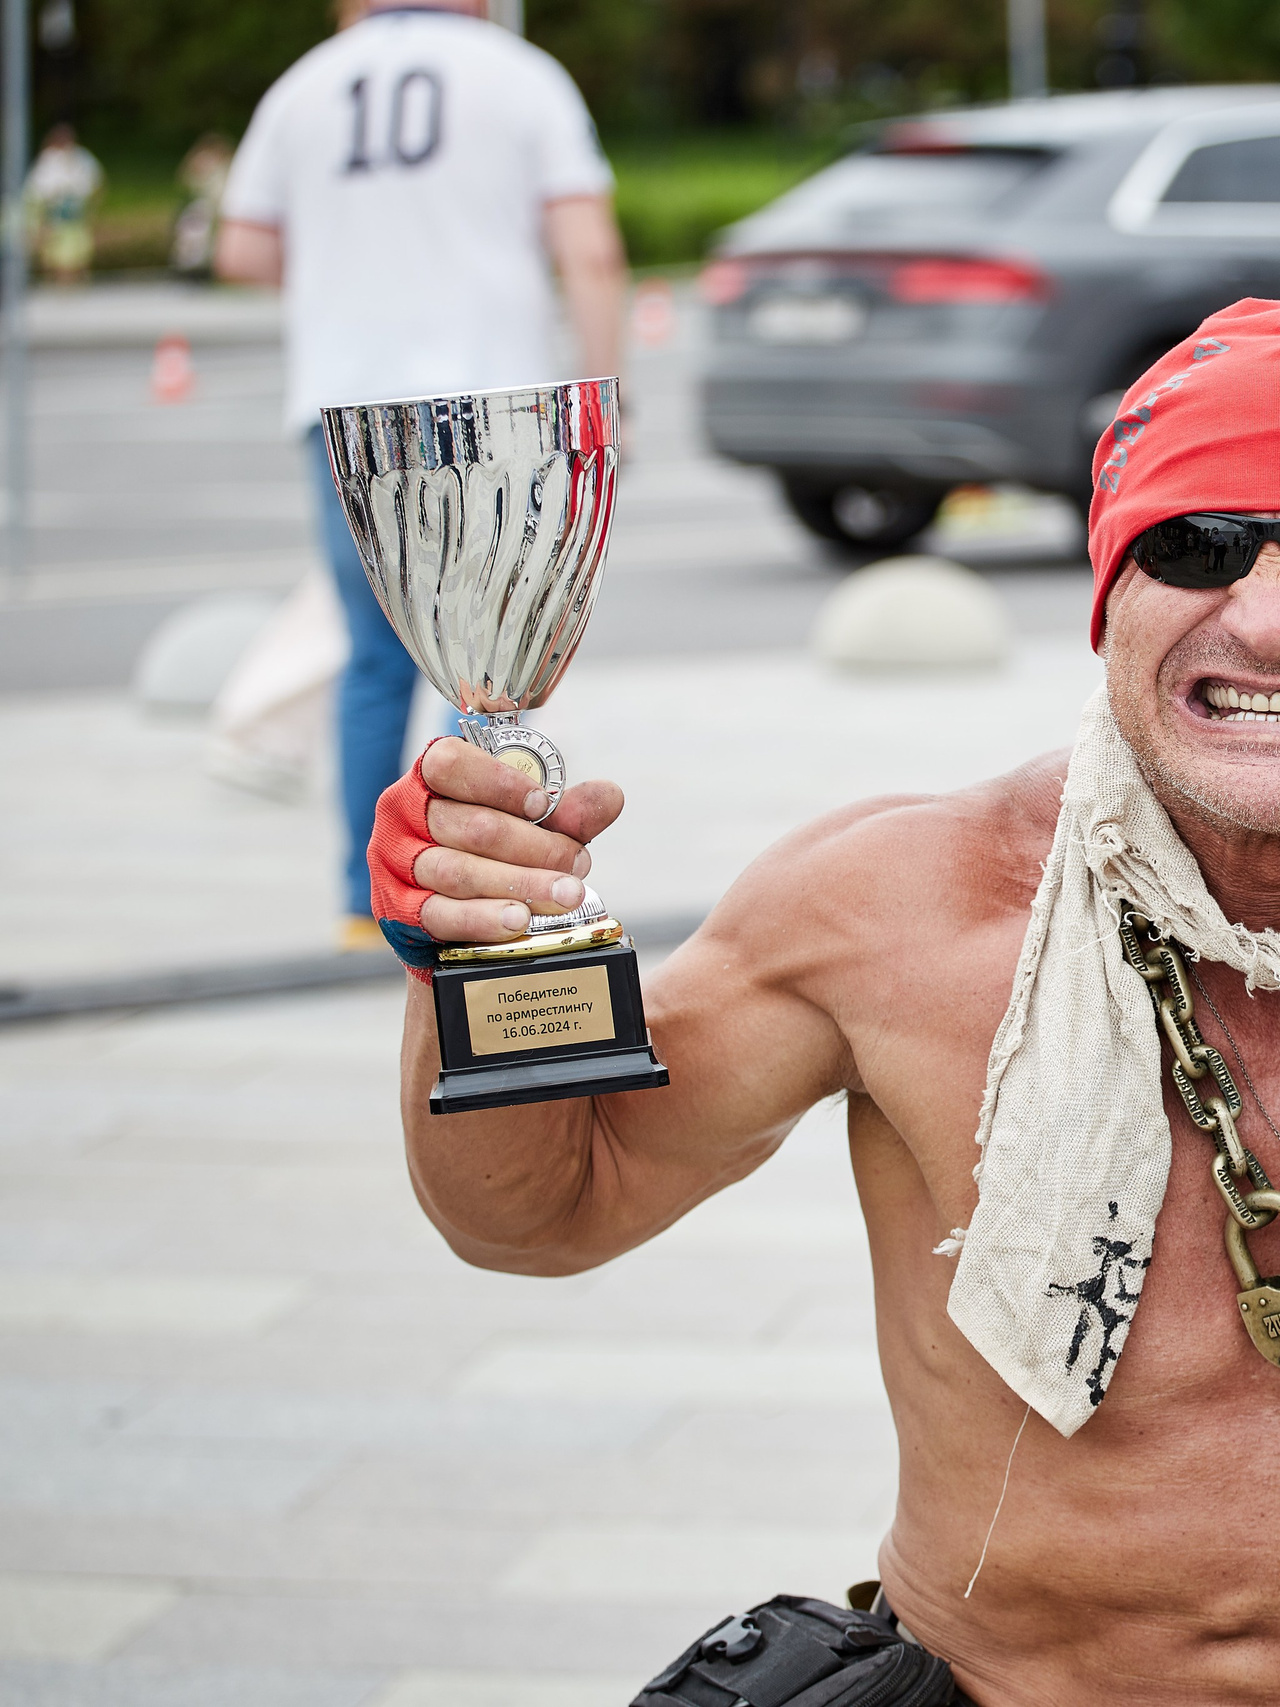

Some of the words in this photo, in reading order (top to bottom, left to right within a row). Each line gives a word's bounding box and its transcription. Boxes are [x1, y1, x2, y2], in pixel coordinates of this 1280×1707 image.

[342, 68, 443, 175] 10
[1100, 337, 1231, 494] ZUBV
[487, 1012, 502, 1023] по
[505, 1001, 593, 1022] армрестлингу
[498, 985, 578, 1004] Победителю
[502, 1020, 571, 1039] 16.06.2024
[574, 1021, 582, 1030] г.
[1206, 1049, 1241, 1110] ZUBRINOV
